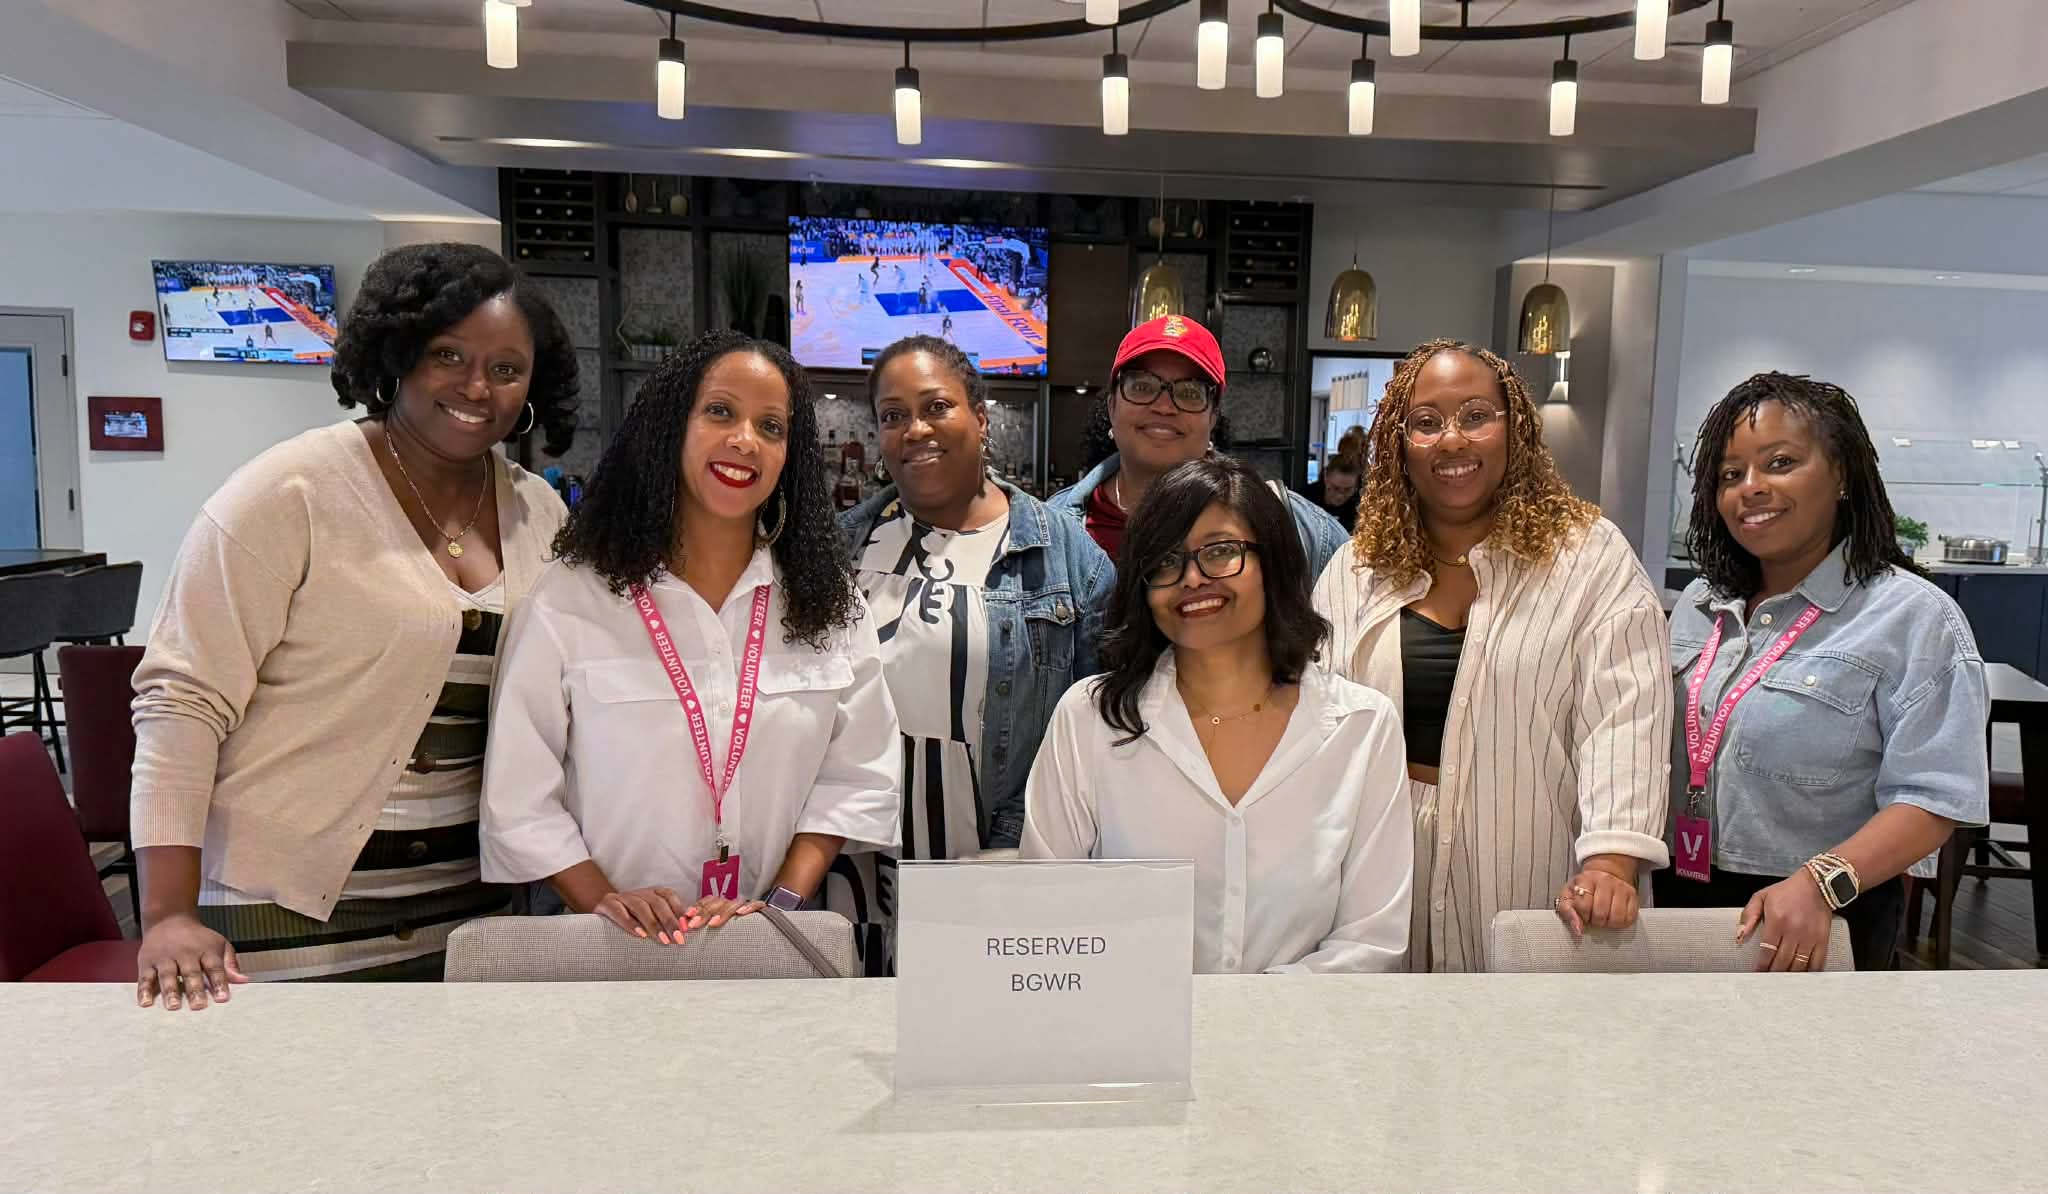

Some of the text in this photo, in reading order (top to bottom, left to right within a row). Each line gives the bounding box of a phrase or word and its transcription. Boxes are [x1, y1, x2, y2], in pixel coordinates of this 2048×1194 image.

[983, 295, 1043, 341] Final Four
[655, 631, 691, 697] VOLUNTEER
[740, 643, 760, 709] VOLUNTEER
[1738, 640, 1790, 690] VOLUNTEER
[691, 712, 713, 784] VOLUNTEER
[1687, 686, 1700, 749] VOLUNTEER
[1698, 703, 1732, 764] VOLUNTEER
[986, 936, 1107, 956] RESERVED
[1011, 973, 1082, 992] BGWR
